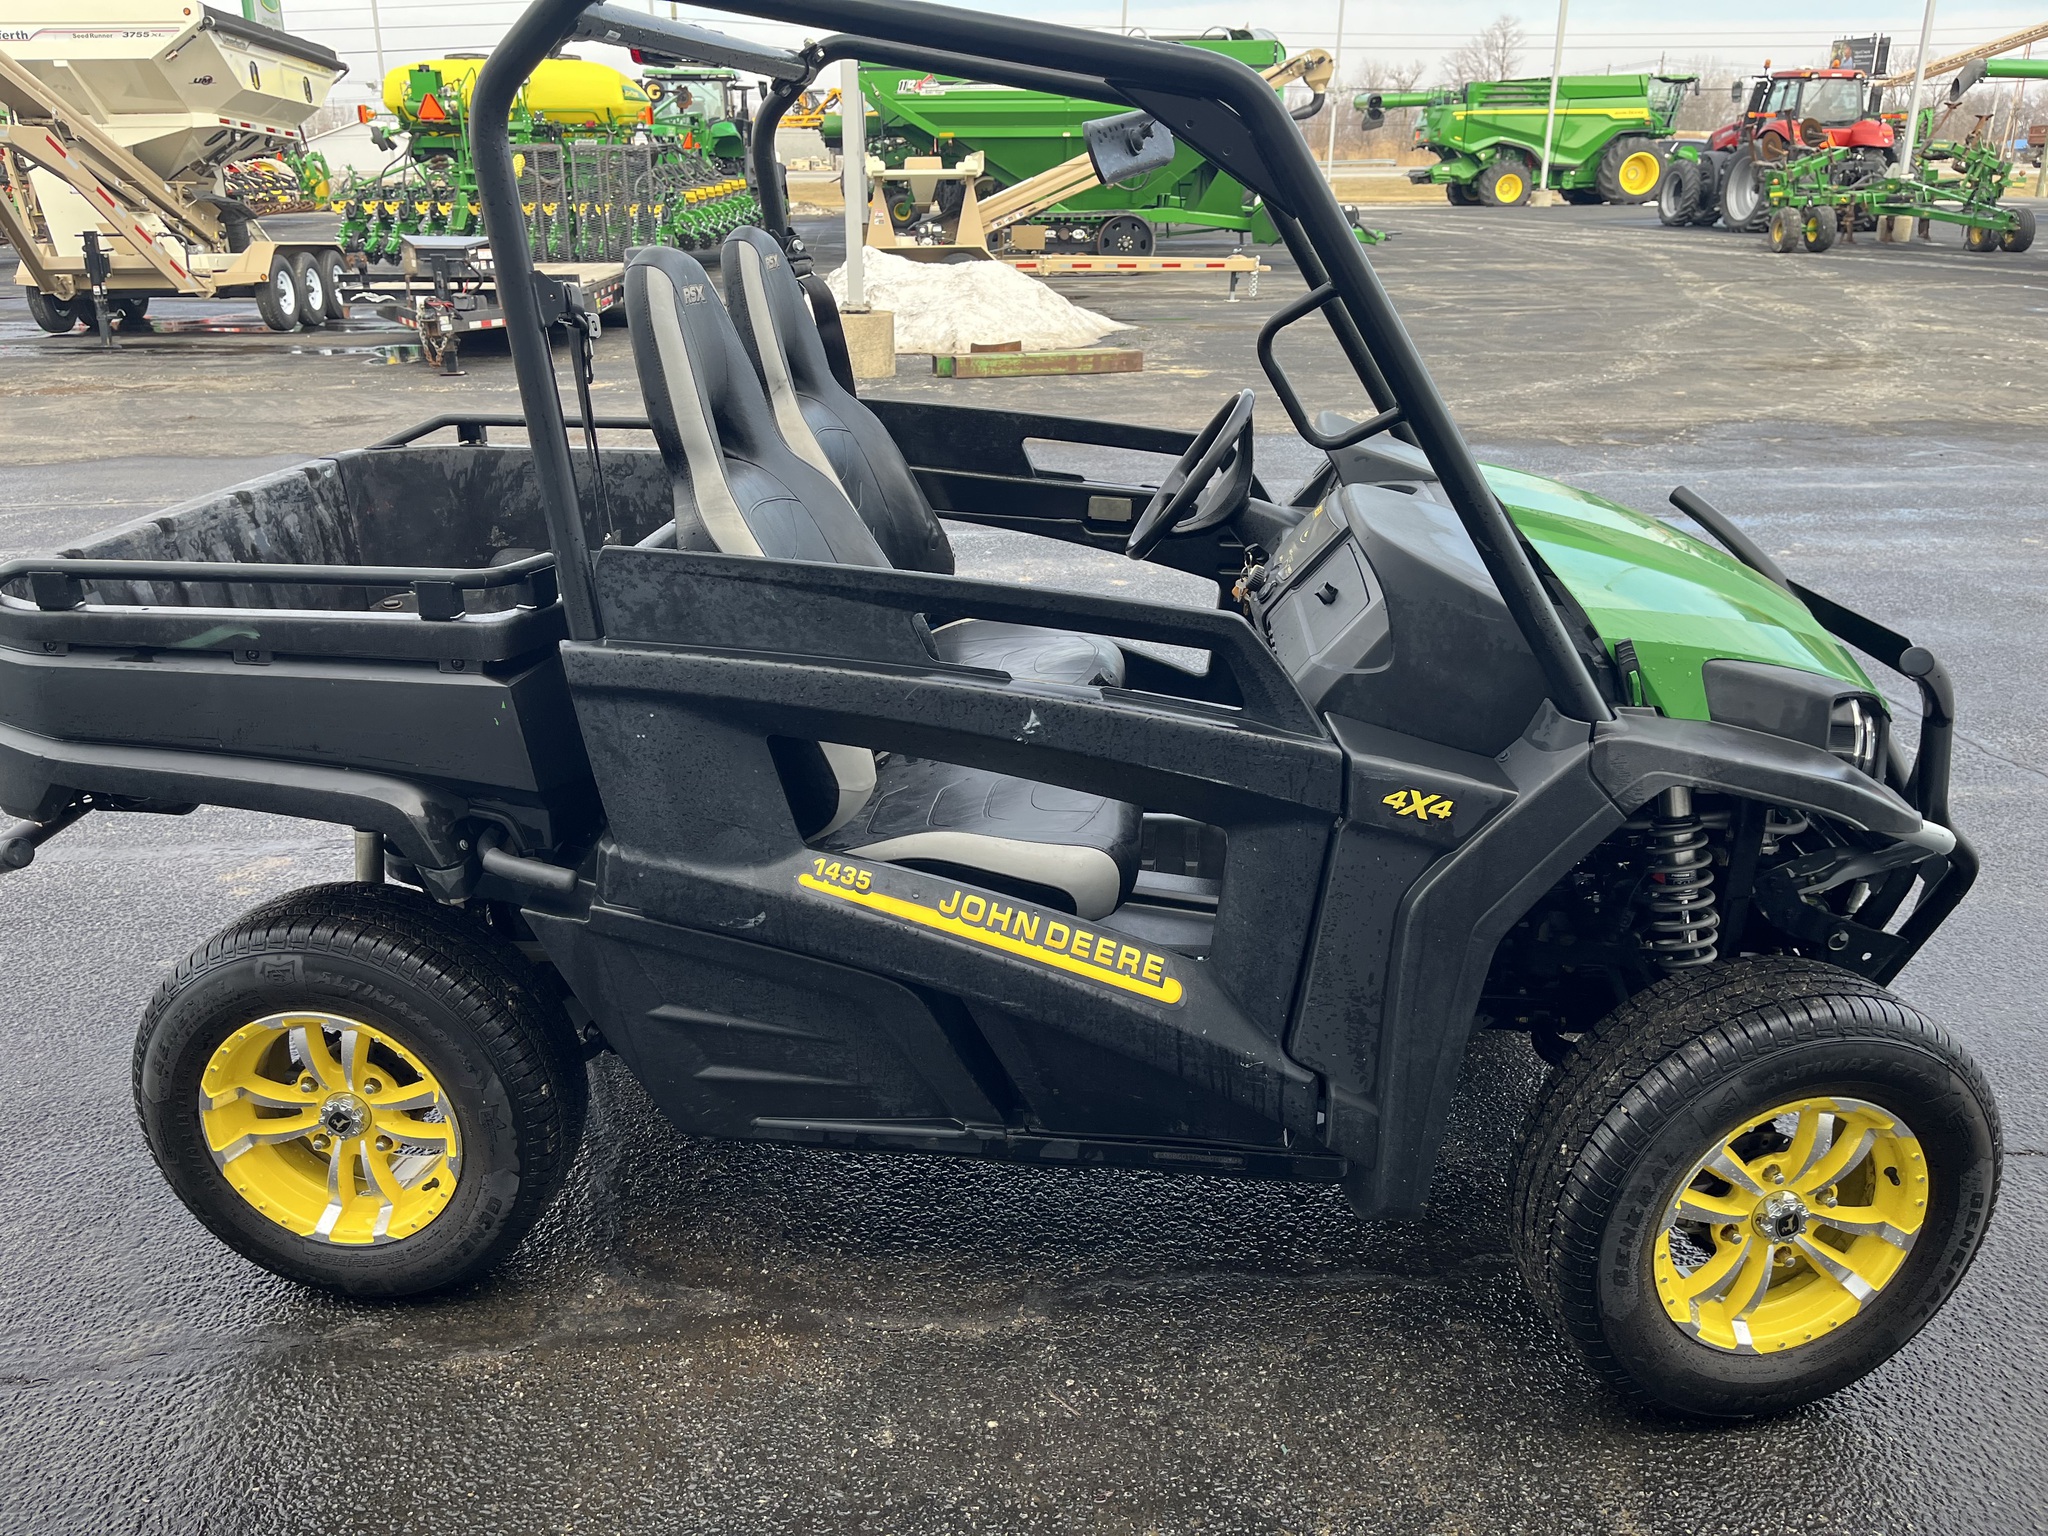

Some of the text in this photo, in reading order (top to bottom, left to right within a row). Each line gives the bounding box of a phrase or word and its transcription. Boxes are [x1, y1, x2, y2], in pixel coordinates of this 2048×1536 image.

[765, 254, 780, 271] RSX
[682, 284, 707, 306] RSX
[1382, 789, 1454, 821] 4X4
[812, 857, 874, 891] 1435
[938, 890, 1166, 983] JOHN DEERE
[313, 971, 430, 1027] ALTIMAX
[1612, 1151, 1685, 1287] GENERAL
[1911, 1191, 1985, 1318] GENERAL
